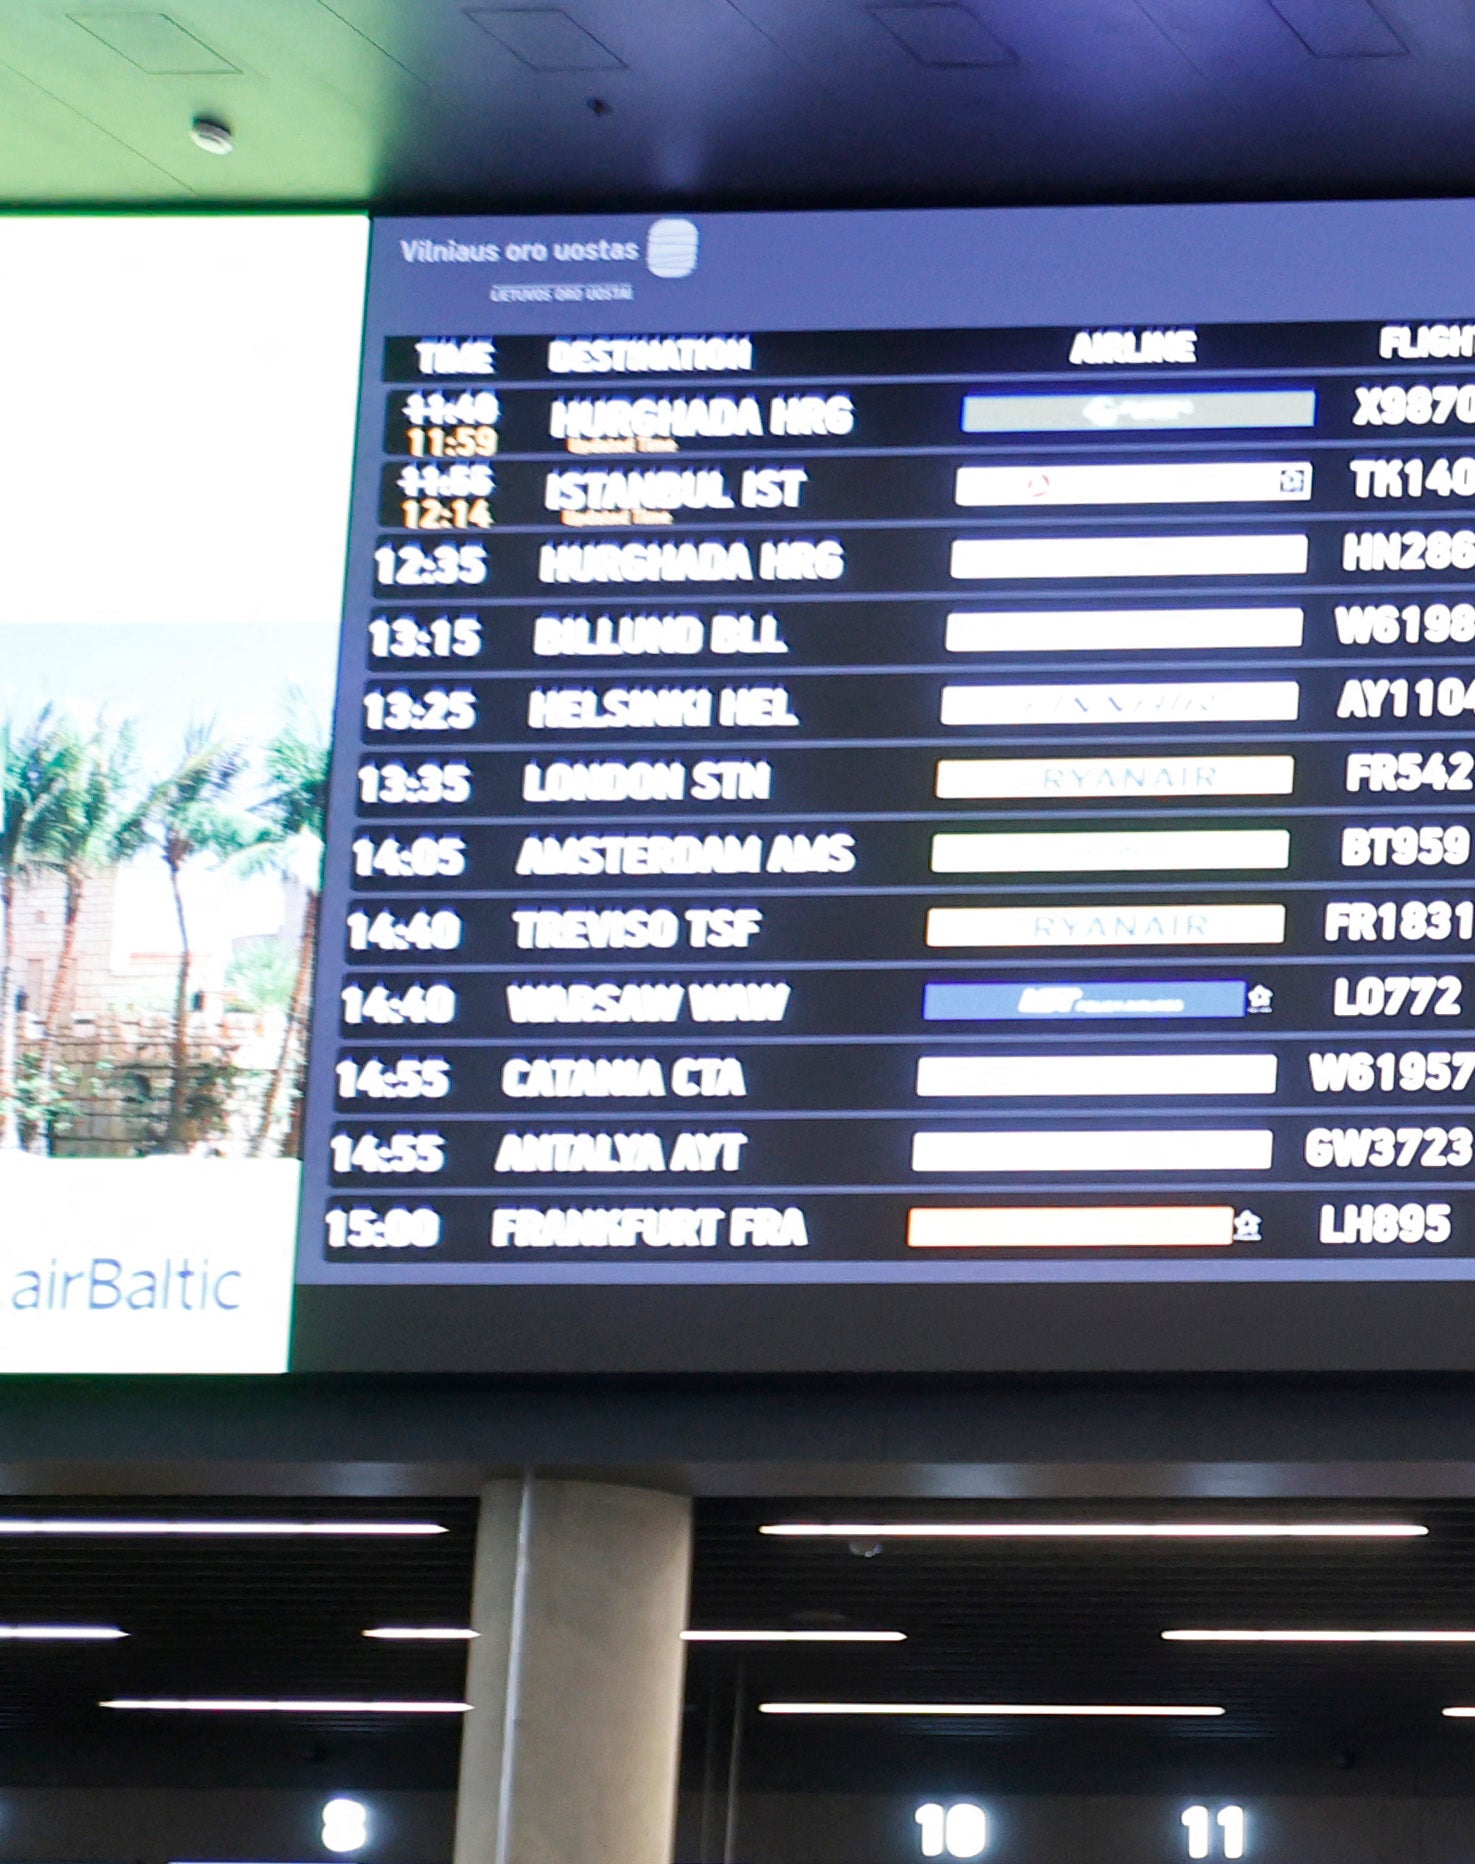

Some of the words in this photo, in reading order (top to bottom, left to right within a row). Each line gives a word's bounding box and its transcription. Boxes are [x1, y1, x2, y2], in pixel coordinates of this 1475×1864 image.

[400, 239, 500, 263] Vilniaus
[505, 242, 548, 262] oro
[553, 239, 639, 261] uostas
[548, 338, 752, 373] DESTINATION
[1069, 330, 1197, 364] AIRLINE
[407, 427, 498, 456] 11:59
[402, 499, 493, 529] 12:14
[369, 619, 480, 657] 13:15
[534, 616, 703, 655] BILLUND
[711, 615, 788, 654] BLL
[358, 764, 470, 803] 13:35
[523, 762, 684, 802] LONDON
[691, 761, 770, 800] STN
[1042, 767, 1217, 789] RYANAIR
[1346, 751, 1474, 792] FR542
[347, 911, 460, 950] 14:40
[512, 909, 678, 949] TREVISO
[685, 909, 763, 947] TSF
[1034, 915, 1208, 937] RYANAIR
[1325, 901, 1473, 941] FR1831
[11, 1257, 241, 1310] airBaltic
[323, 1799, 366, 1852] 8
[915, 1803, 986, 1858] 10
[1181, 1805, 1243, 1858] 11
